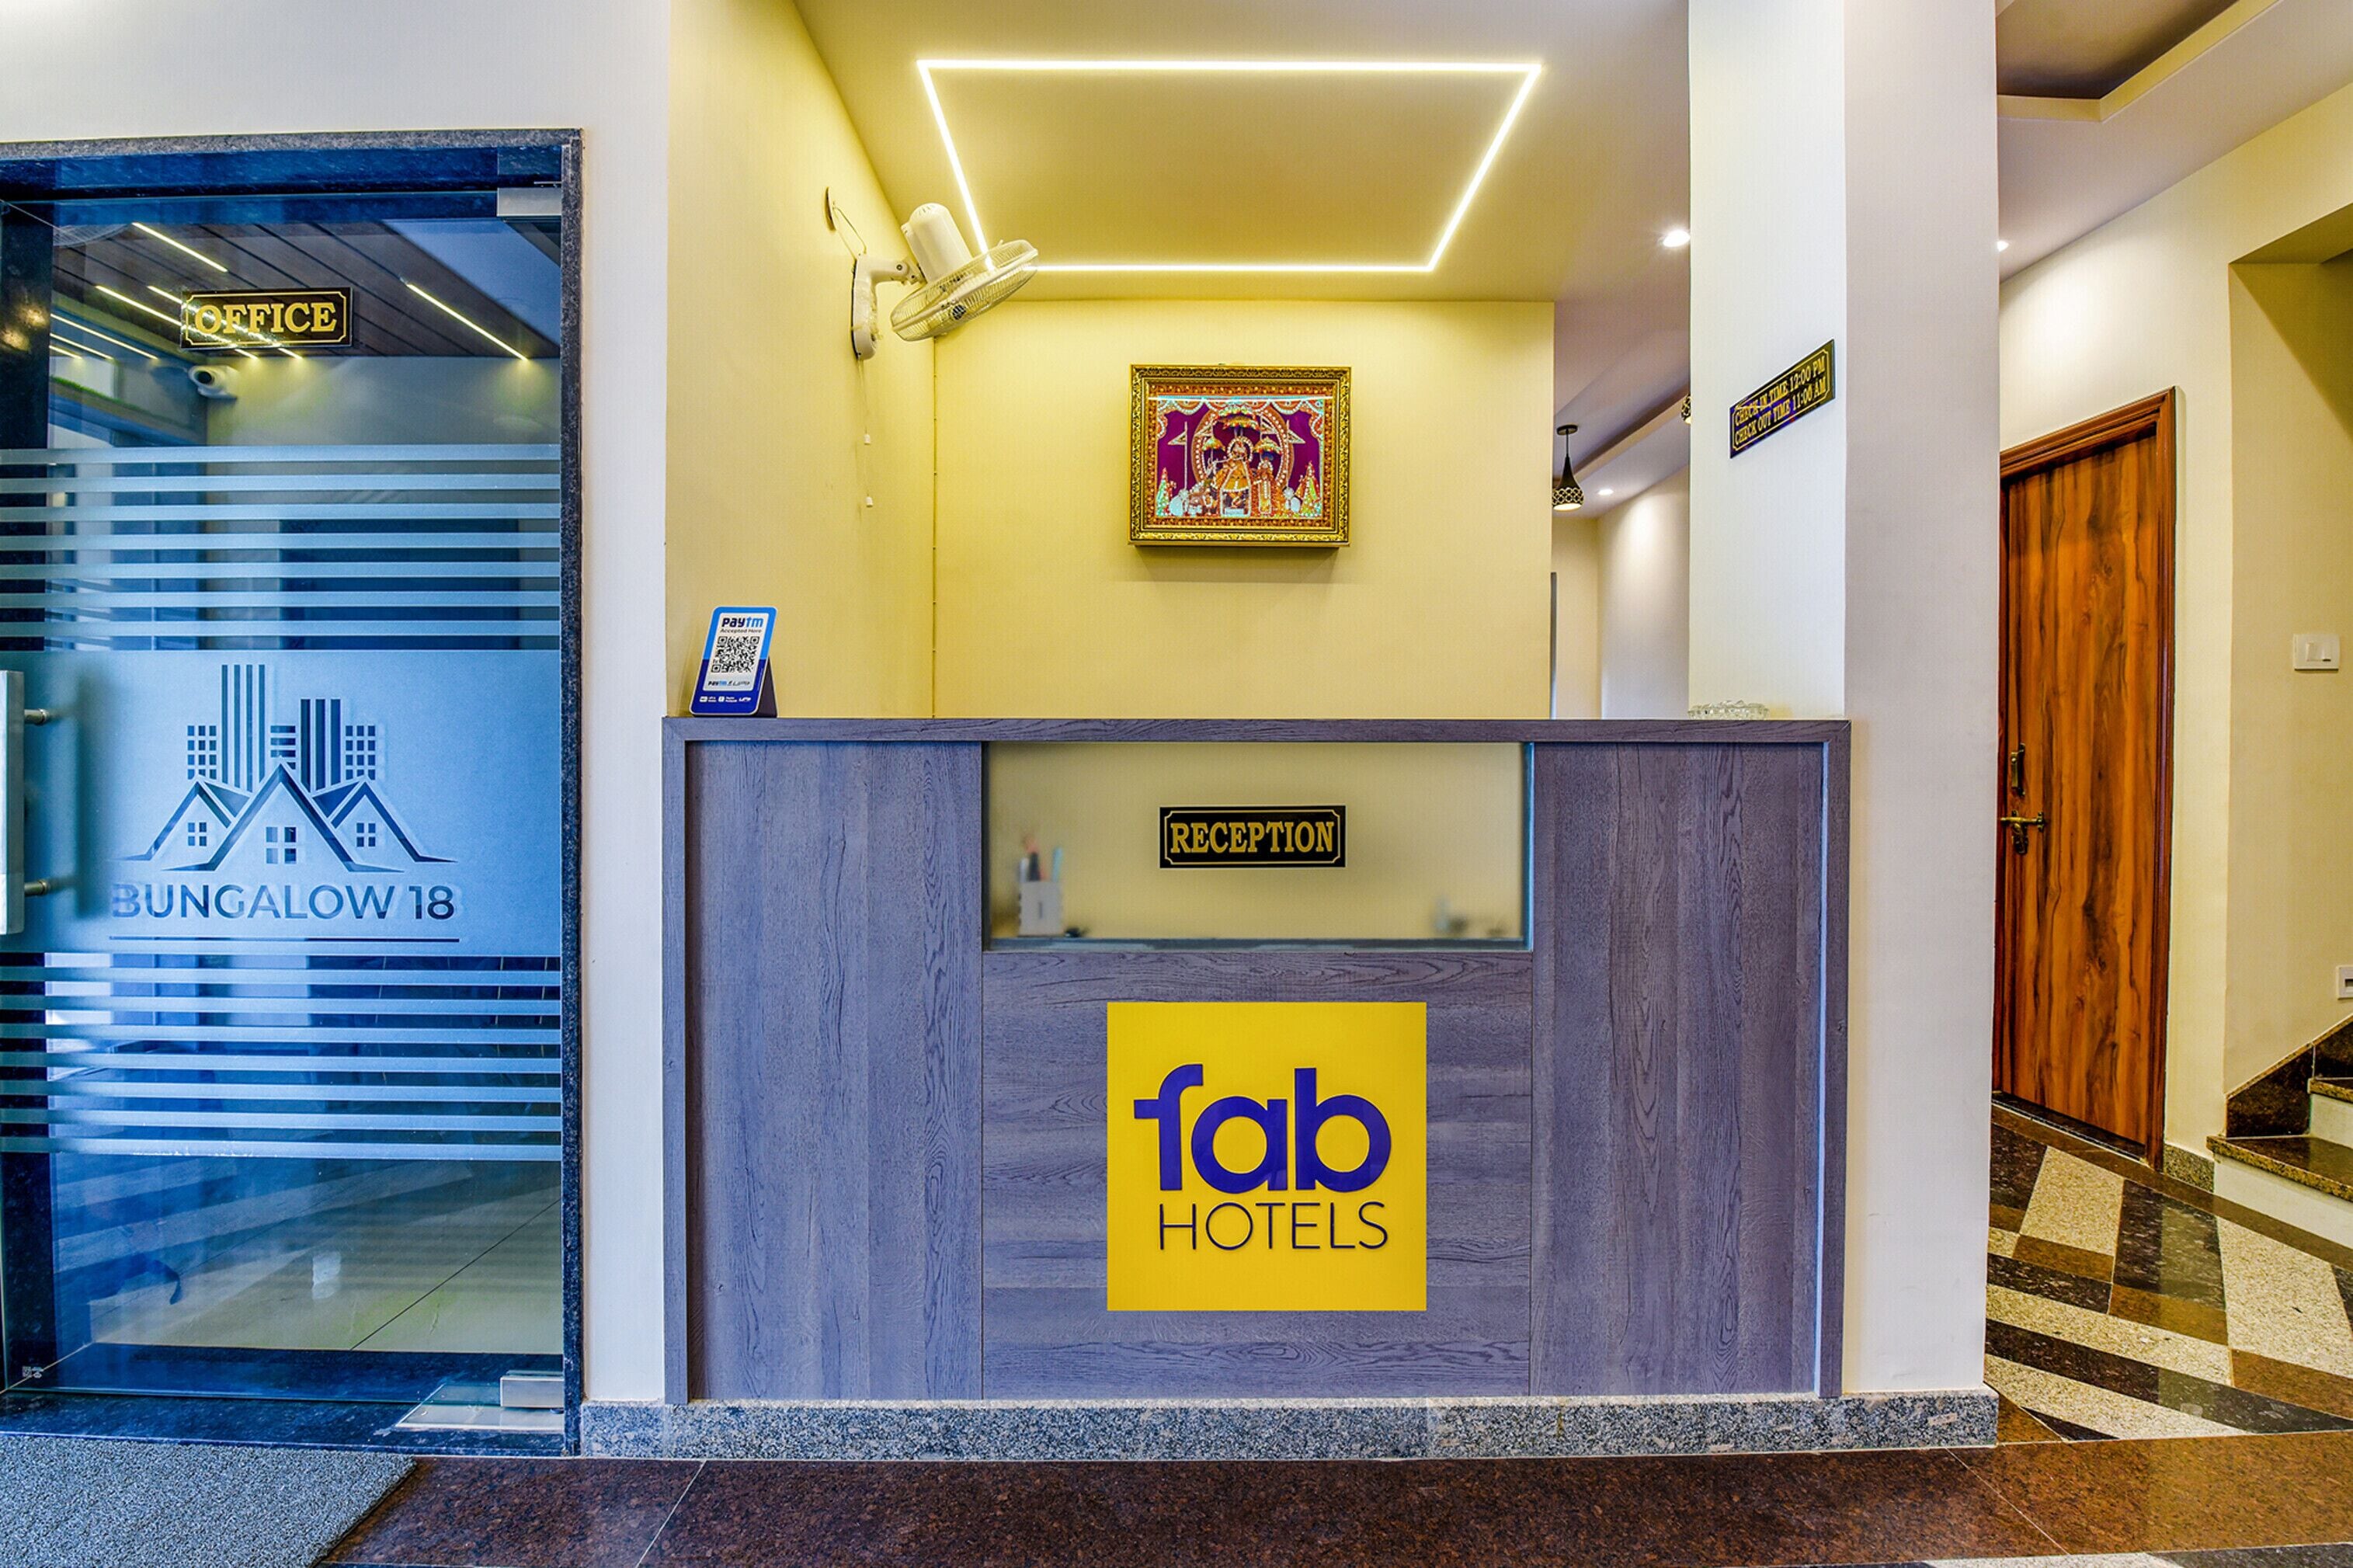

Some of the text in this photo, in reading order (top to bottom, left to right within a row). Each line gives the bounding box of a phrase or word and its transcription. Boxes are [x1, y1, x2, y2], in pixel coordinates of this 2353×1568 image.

[195, 303, 337, 334] OFFICE
[1735, 356, 1826, 426] CHECK IN TIME 12:00 PM
[1735, 377, 1826, 445] CHECK OUT TIME 11:00 AM
[1170, 821, 1334, 854] RECEPTION
[112, 884, 455, 920] BUNGALOW 18
[1134, 1064, 1392, 1194] fab
[1159, 1201, 1389, 1250] HOTELS
